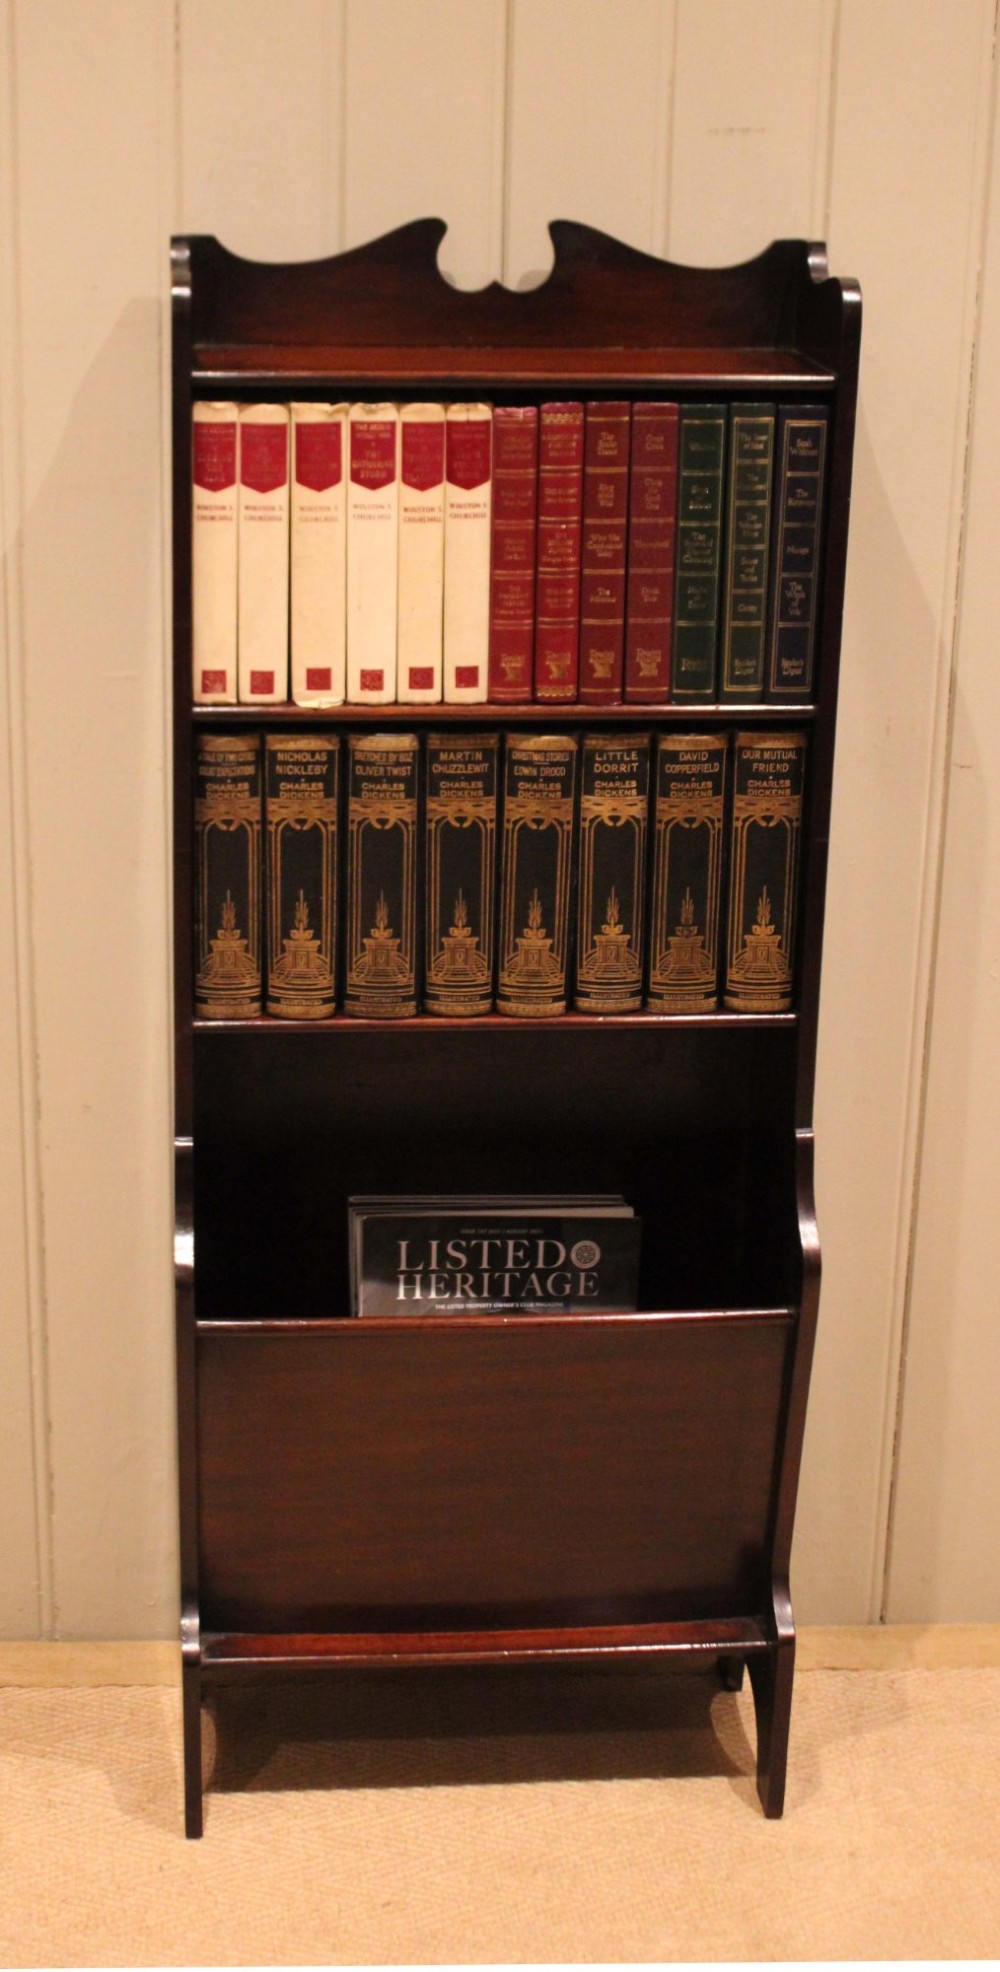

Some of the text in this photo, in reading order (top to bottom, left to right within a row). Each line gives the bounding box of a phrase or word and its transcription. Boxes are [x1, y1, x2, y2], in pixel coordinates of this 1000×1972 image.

[277, 752, 327, 761] NICHOLAS
[440, 751, 482, 760] MARTIN
[595, 751, 638, 760] LITTLE
[680, 751, 708, 760] DAVID
[742, 750, 797, 759] OUR MUTUAL
[276, 764, 328, 775] NICKLEBY
[356, 766, 411, 776] OLIVER TWIST
[432, 763, 489, 774] CHUZZLEWIT
[514, 765, 565, 776] EDWIN DROOD
[594, 763, 638, 773] DORRIT
[665, 762, 719, 773] COPPERFIELD
[752, 762, 789, 772] FRIEND
[206, 782, 249, 791] CHARLES
[280, 782, 324, 790] CHARLES
[362, 782, 405, 791] CHARLES
[440, 781, 483, 789] CHARLES
[518, 782, 561, 790] CHARLES
[595, 780, 637, 788] CHARLES
[670, 781, 712, 789] CHARLES
[747, 780, 790, 788] CHARLES
[206, 791, 250, 800] DICKENS
[280, 791, 324, 800] DICKENS
[362, 791, 405, 799] DICKENS
[440, 789, 483, 797] DICKENS
[518, 791, 561, 799] DICKENS
[594, 789, 637, 797] DICKENS
[670, 790, 713, 798] DICKENS
[747, 788, 791, 796] DICKENS
[397, 1239, 566, 1271] LISTED
[395, 1271, 599, 1300] HERITAGE
